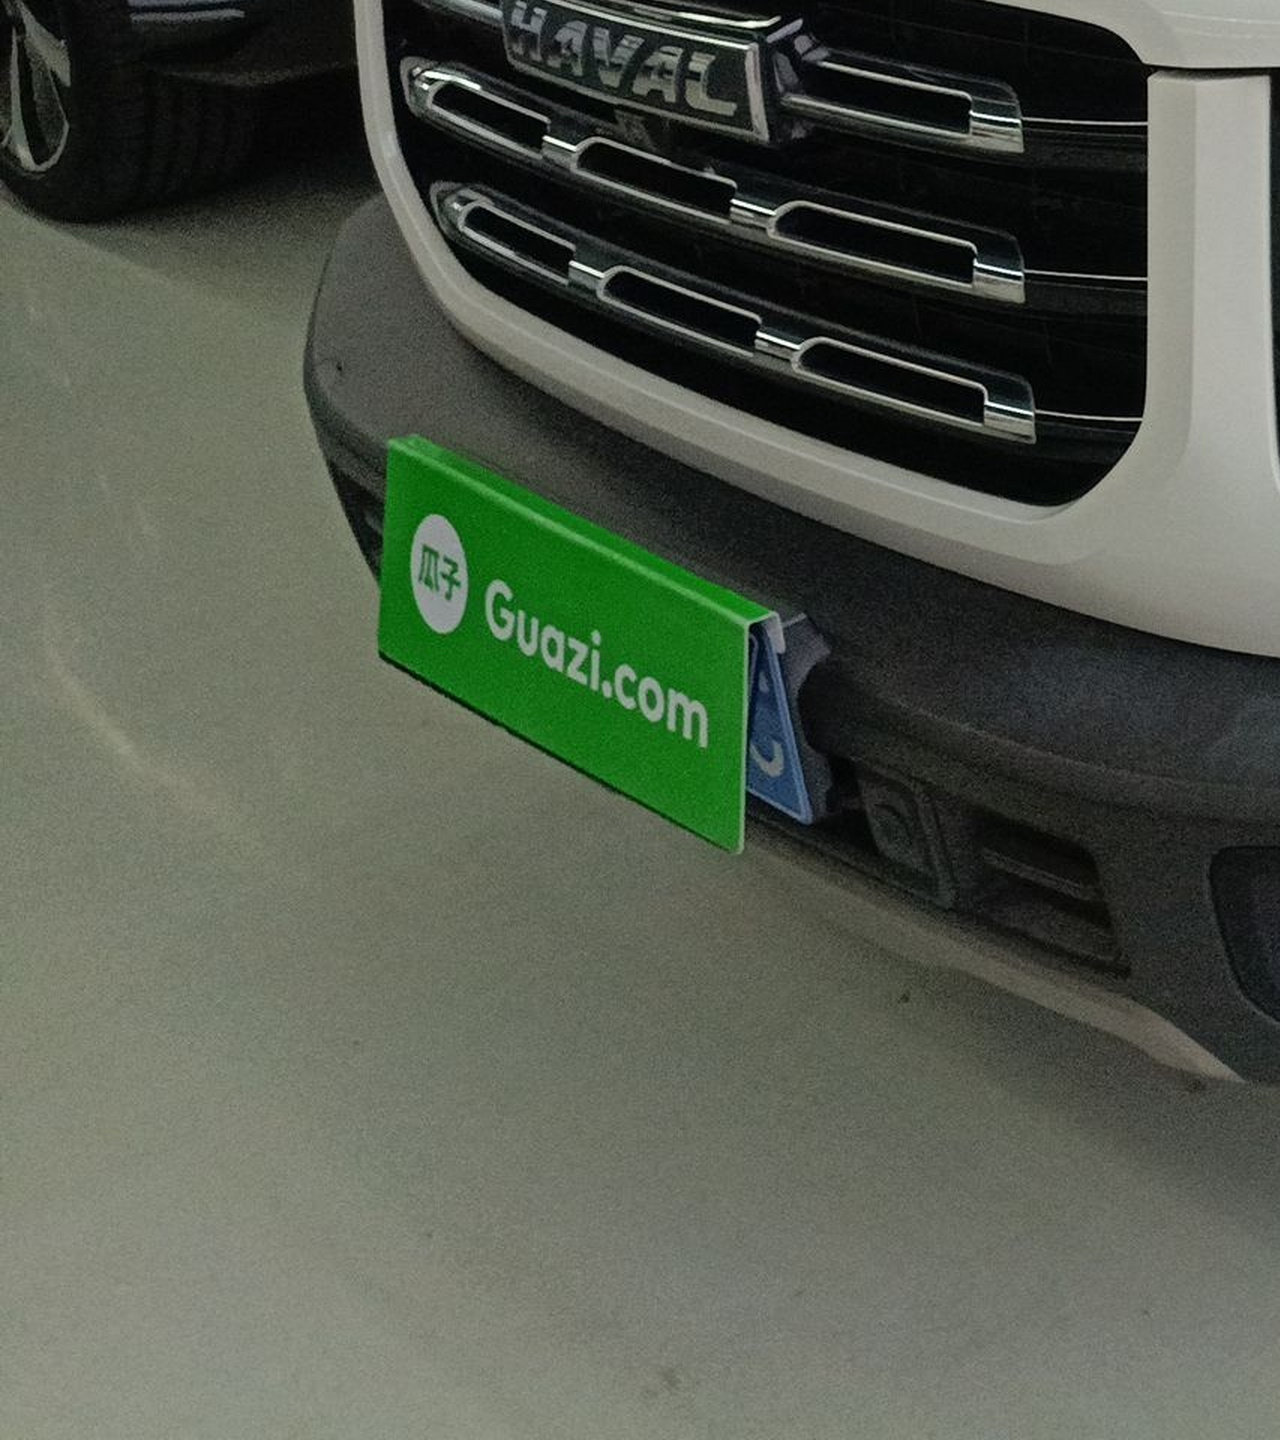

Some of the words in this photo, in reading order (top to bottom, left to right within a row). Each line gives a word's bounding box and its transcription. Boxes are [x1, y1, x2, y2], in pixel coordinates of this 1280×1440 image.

[511, 0, 737, 117] HAVAL
[418, 544, 461, 601] 瓜子
[484, 578, 709, 749] Guazi.com
